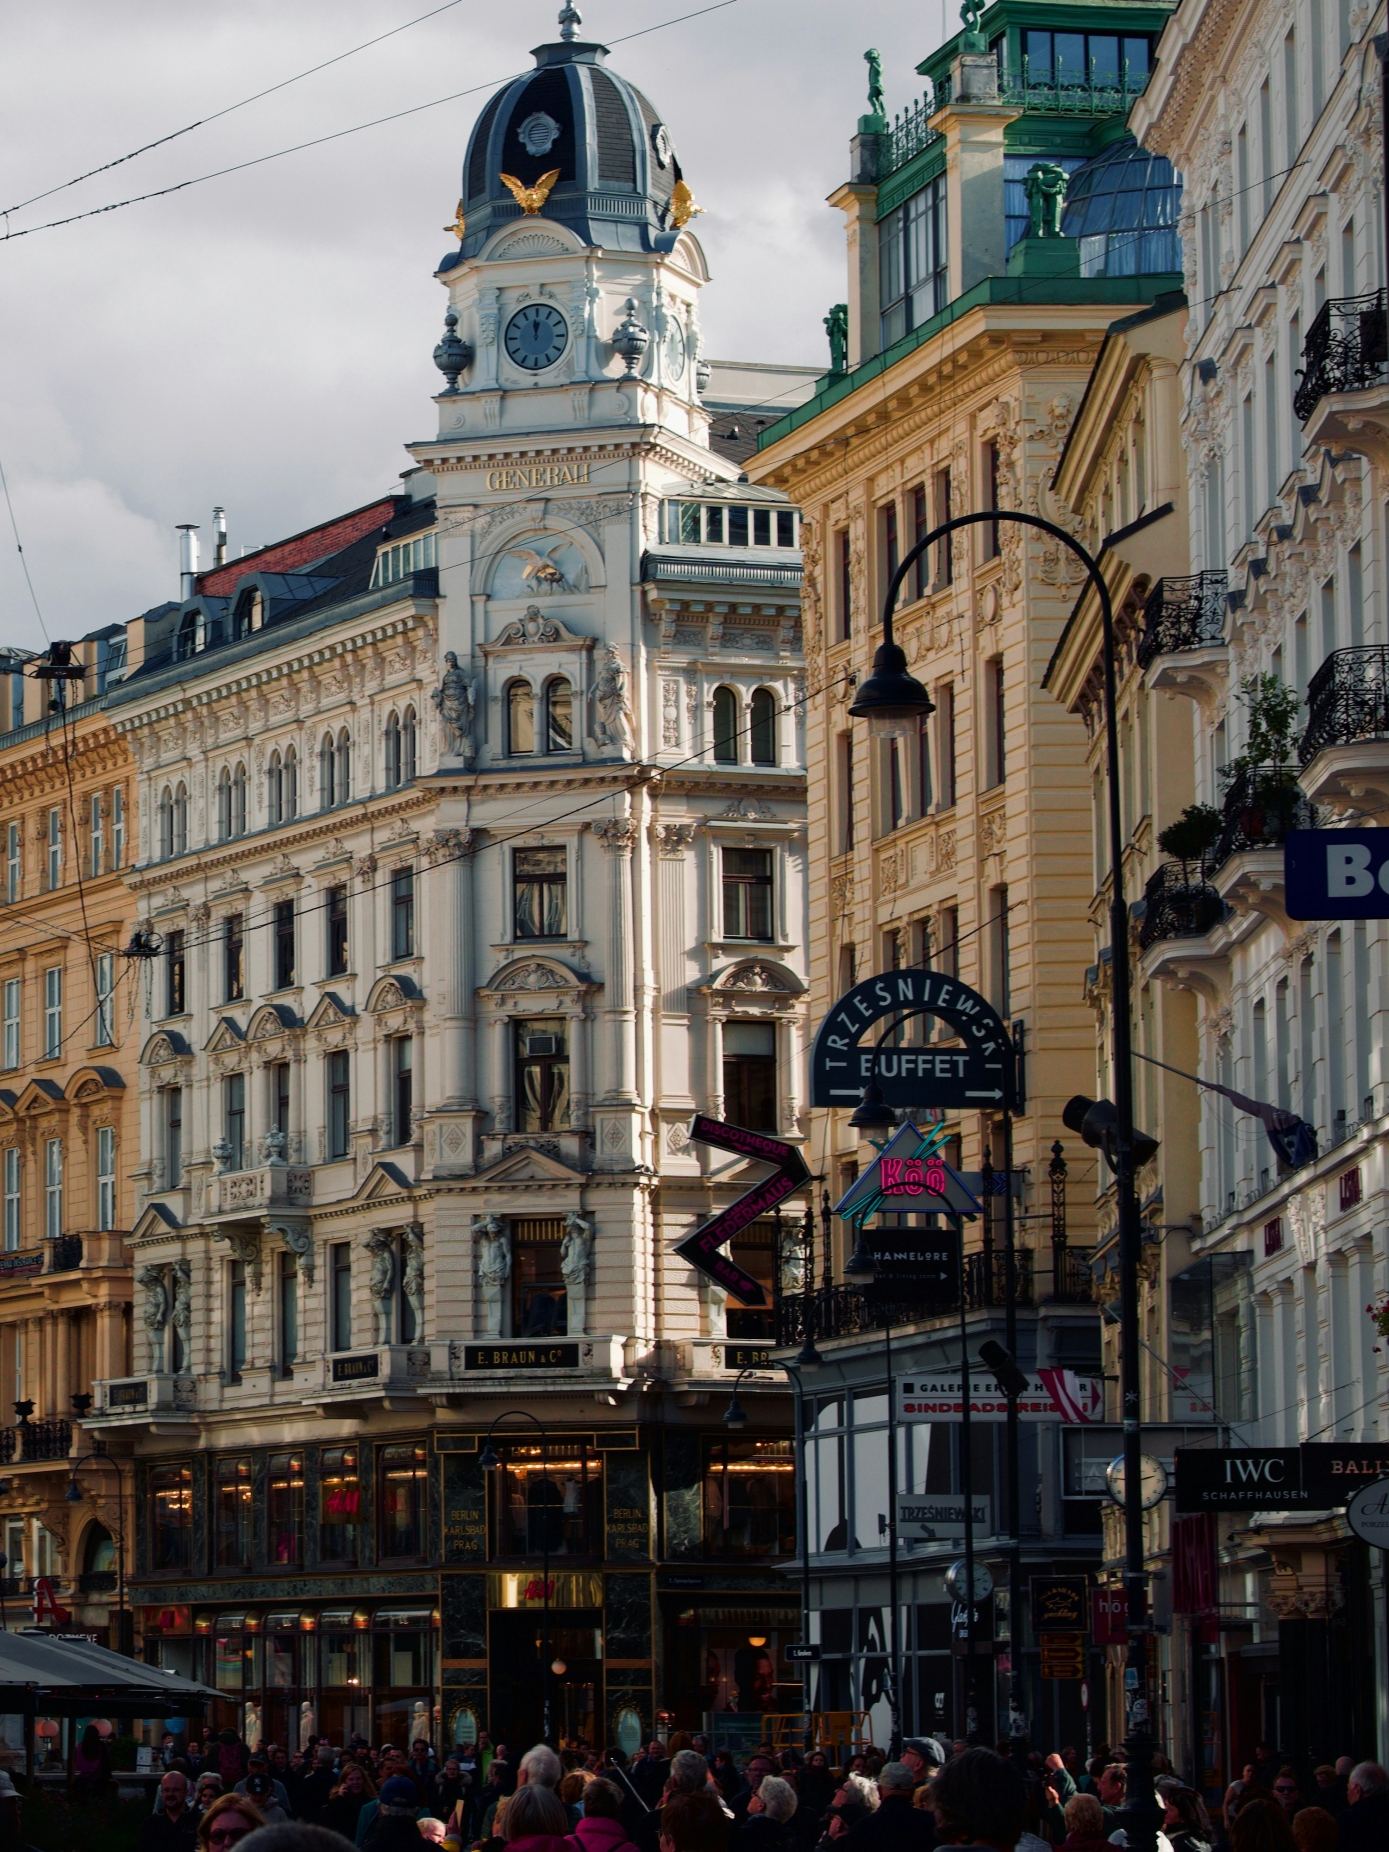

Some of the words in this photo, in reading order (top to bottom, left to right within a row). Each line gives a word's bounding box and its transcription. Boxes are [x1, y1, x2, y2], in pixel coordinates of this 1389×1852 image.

[486, 463, 591, 491] GENERALI
[1326, 844, 1389, 898] B
[860, 1055, 970, 1077] BUFFET
[700, 1119, 790, 1157] DISCOTHEQUE
[880, 1158, 945, 1196] Köö
[698, 1176, 794, 1253] FLEDERMAUS
[725, 1192, 757, 1220] CABARET
[873, 1252, 949, 1260] HANNELORE
[714, 1259, 740, 1283] BAR
[493, 1351, 536, 1364] BRAUN
[540, 1355, 546, 1363] &
[920, 1383, 980, 1392] GALERE
[1223, 1458, 1285, 1484] IWC
[325, 1489, 360, 1515] H&M
[1202, 1490, 1308, 1500] SCHAFFHAUSEN
[451, 1510, 479, 1521] BERLIN
[614, 1508, 642, 1519] BERLIN
[900, 1505, 986, 1520] TRZEŚNIEWKI
[444, 1525, 487, 1536] KARLSBAD
[606, 1523, 648, 1534] KARLSBAD
[453, 1539, 478, 1550] PRAG
[616, 1537, 640, 1549] PRAG
[524, 1579, 554, 1601] H&M
